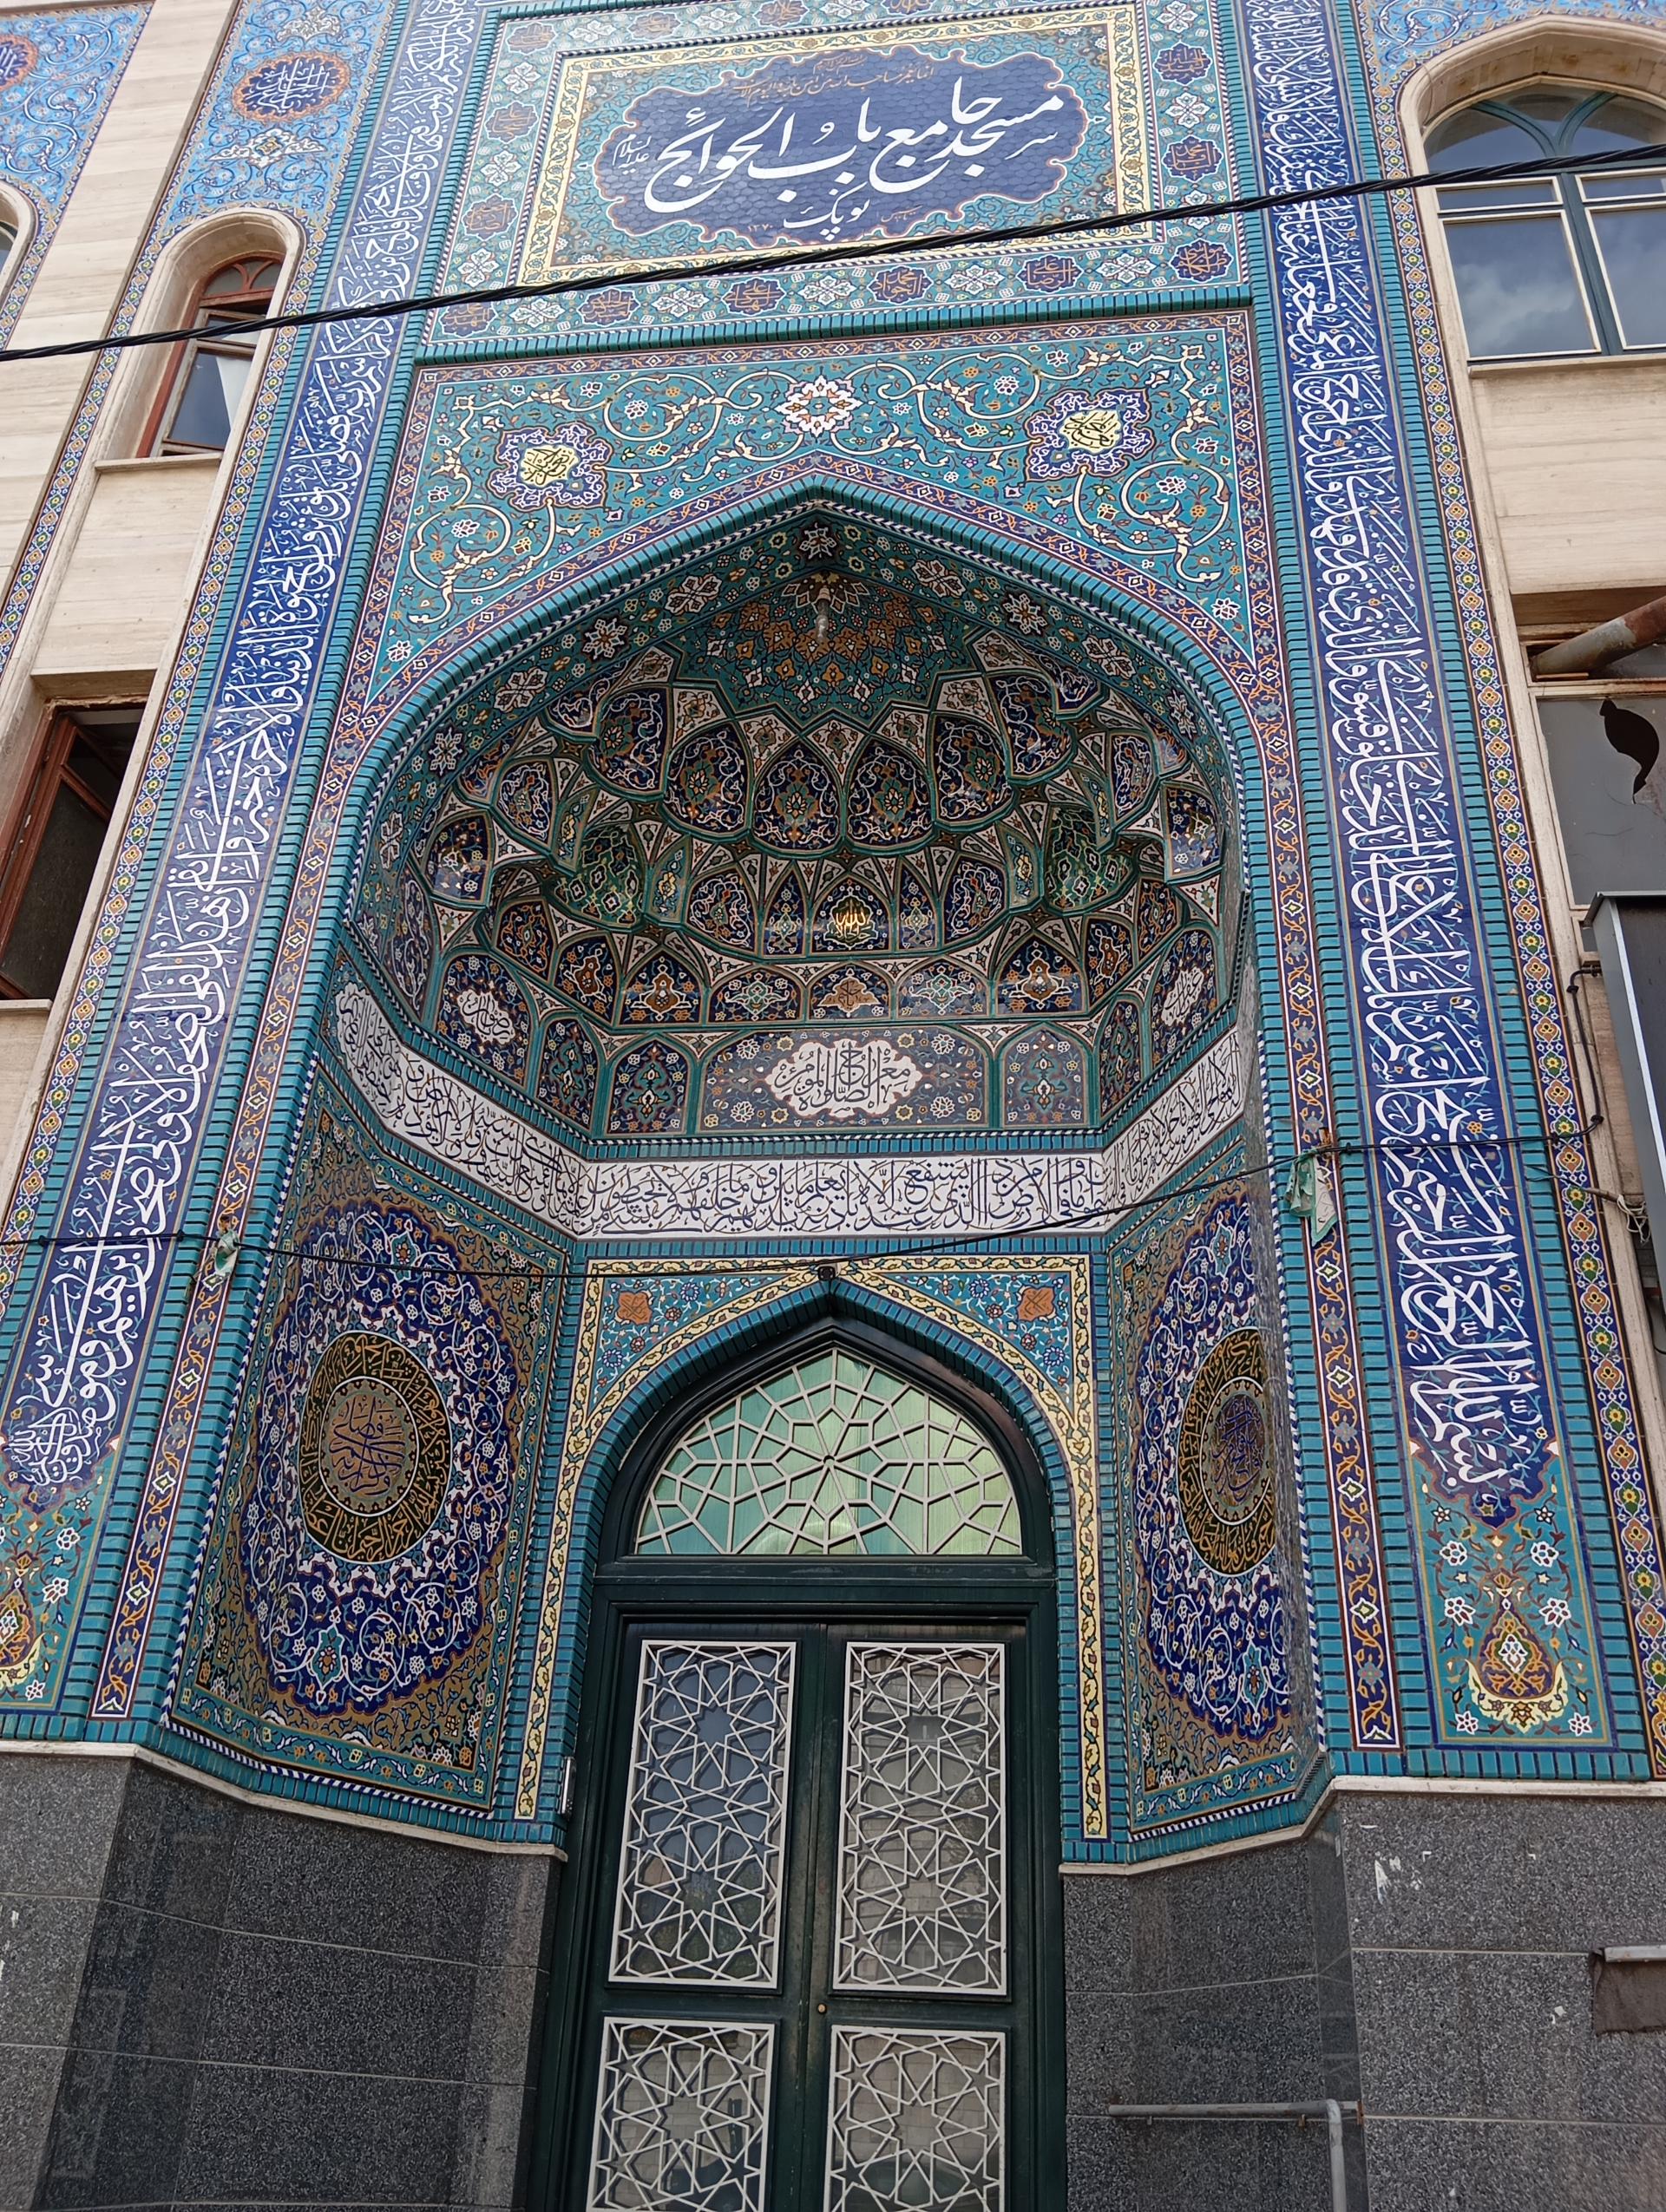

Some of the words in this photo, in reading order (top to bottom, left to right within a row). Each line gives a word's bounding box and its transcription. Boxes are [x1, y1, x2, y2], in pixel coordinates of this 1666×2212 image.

[643, 106, 797, 213] الحوائج
[748, 97, 883, 203] باب
[869, 76, 1004, 194] جامع
[925, 94, 1066, 178] مسجد
[1378, 1136, 1521, 1267] الرحيم
[1388, 1230, 1536, 1371] الرحمن
[1407, 1380, 1512, 1488] بسم
